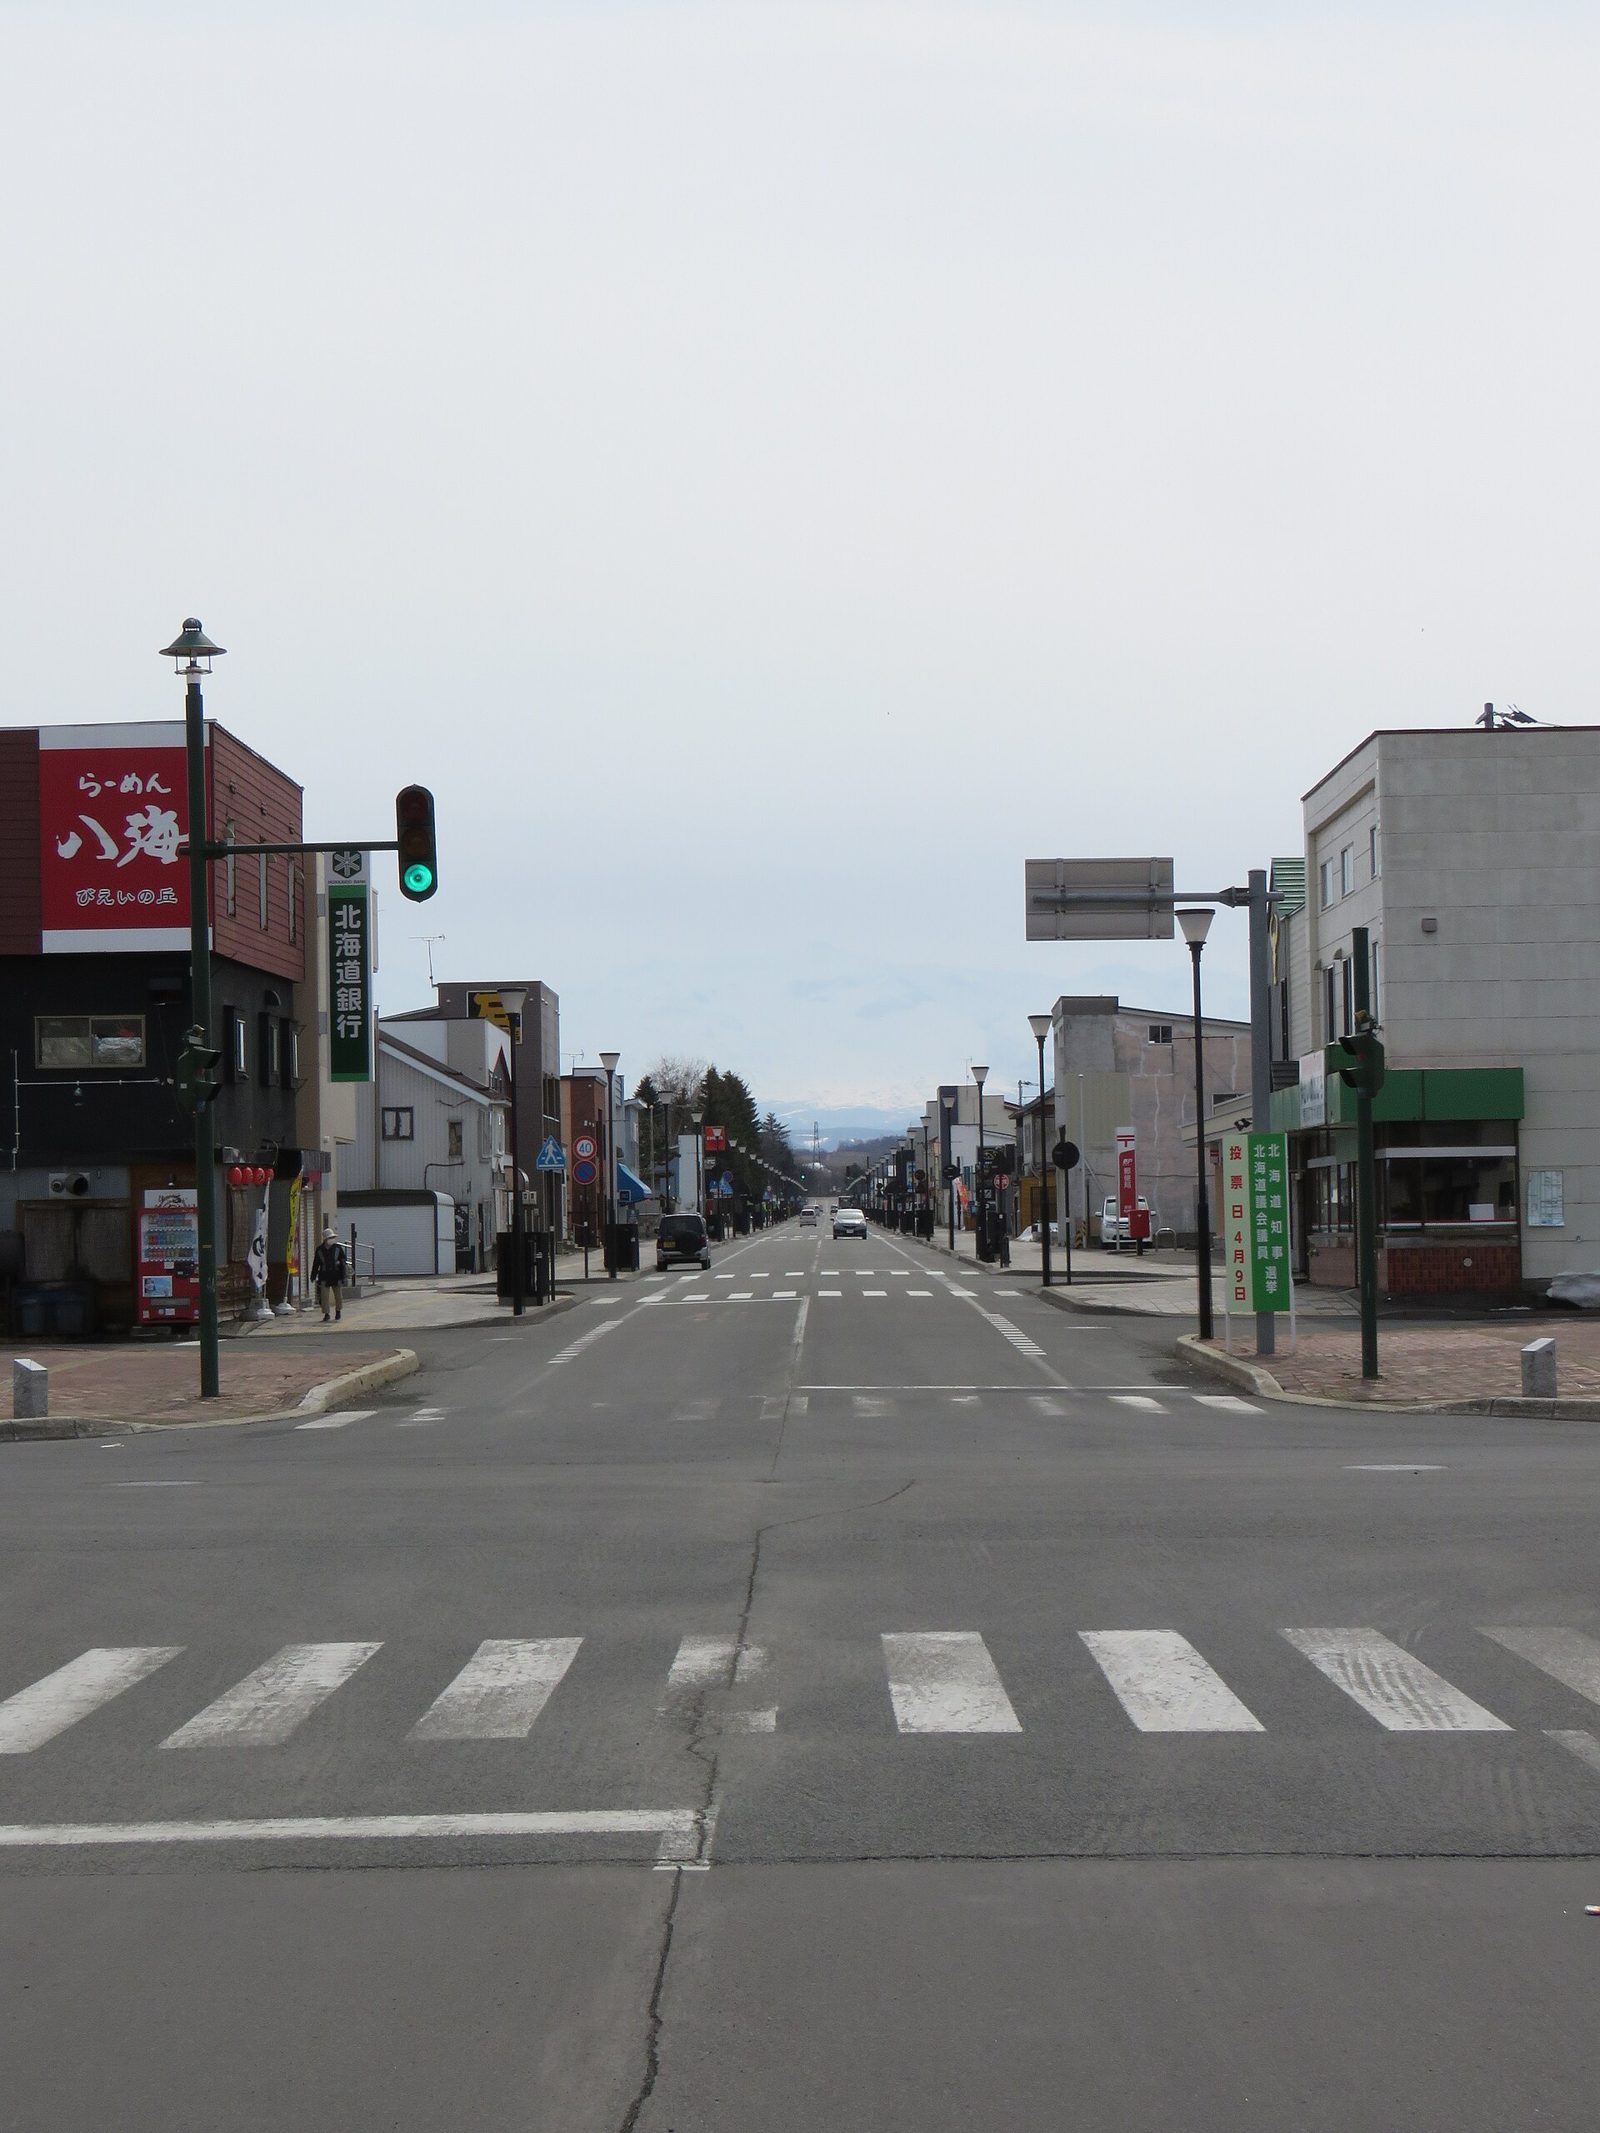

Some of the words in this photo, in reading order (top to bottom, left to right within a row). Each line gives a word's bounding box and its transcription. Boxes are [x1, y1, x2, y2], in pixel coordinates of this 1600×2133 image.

[79, 772, 171, 797] らーめん
[76, 888, 178, 907] びえいの丘
[335, 904, 362, 1039] 北海道銀行
[579, 1142, 592, 1153] 40
[1229, 1146, 1246, 1301] 投票日4月9日
[1254, 1144, 1269, 1260] 北海道議会議員
[1268, 1143, 1283, 1260] 北海道知事
[1265, 1265, 1278, 1294] 選挙
